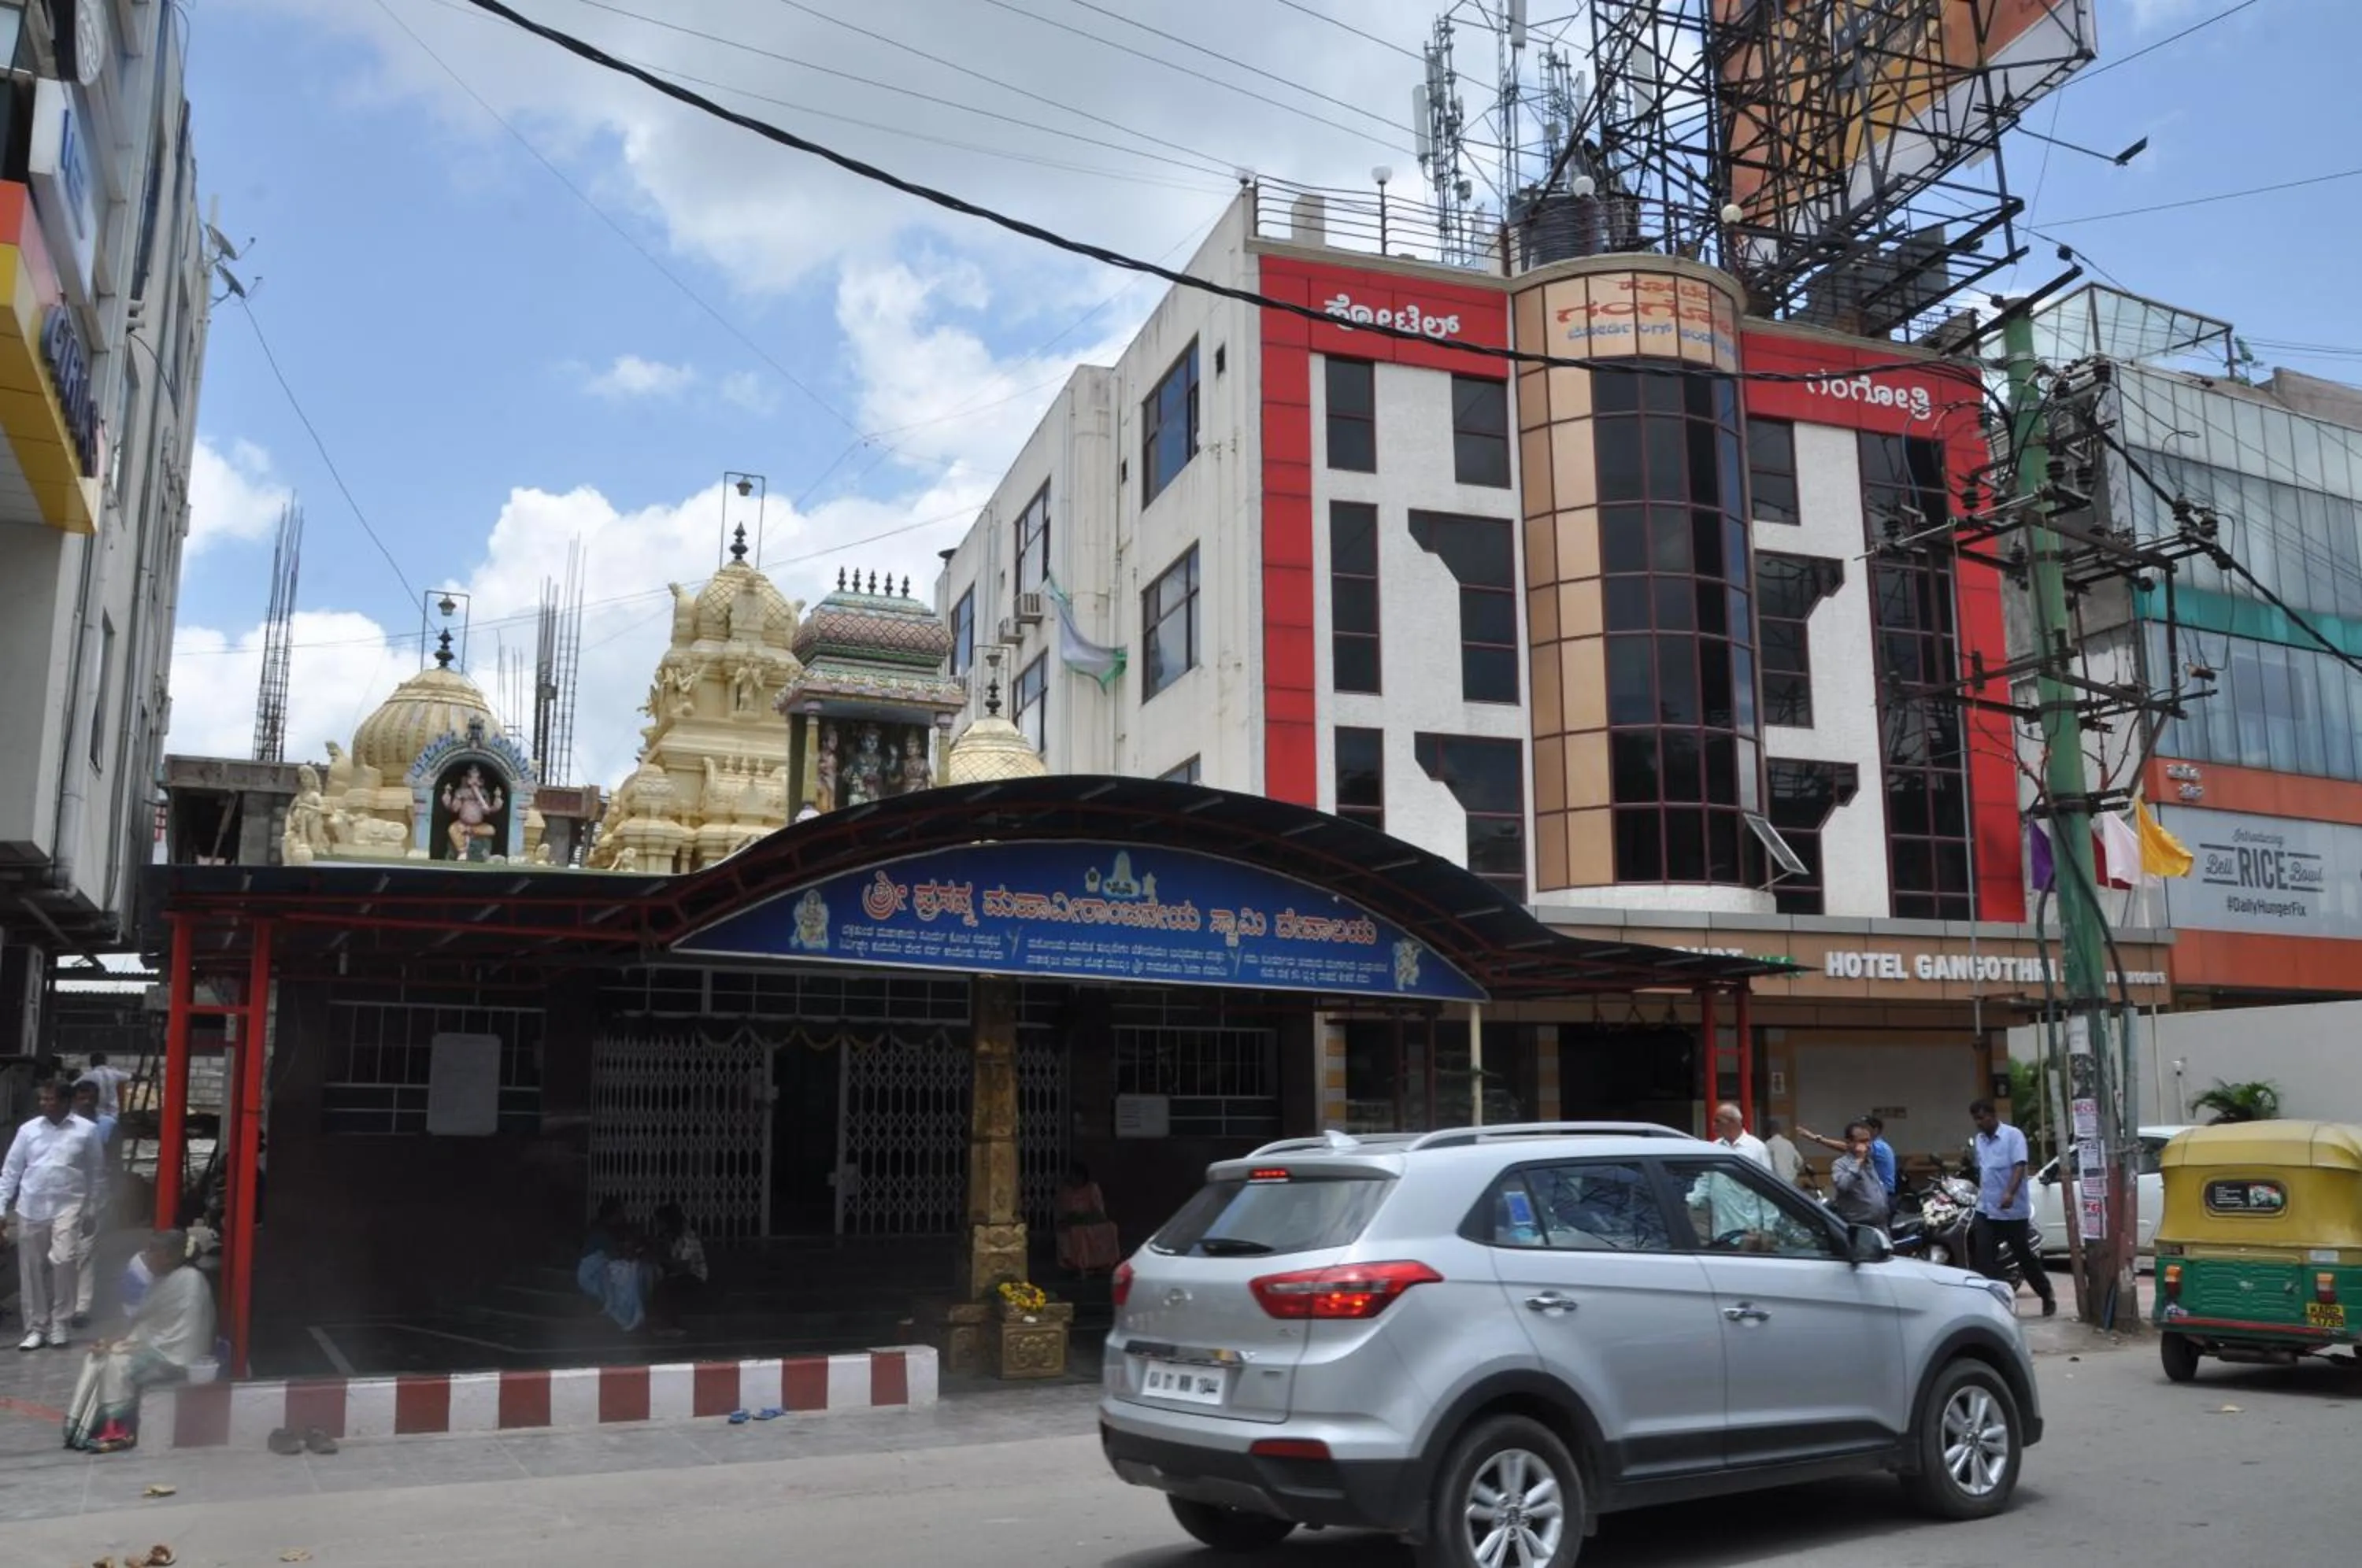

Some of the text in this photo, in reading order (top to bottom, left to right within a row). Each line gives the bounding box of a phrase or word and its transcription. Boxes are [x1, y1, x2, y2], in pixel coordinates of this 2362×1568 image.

[2205, 846, 2323, 890] Bell RICE Bowl
[862, 870, 908, 920] ಶ್ರೀ
[1209, 907, 1267, 948] ಸ್ವಾಮಿ
[1825, 951, 1909, 980] HOTEL
